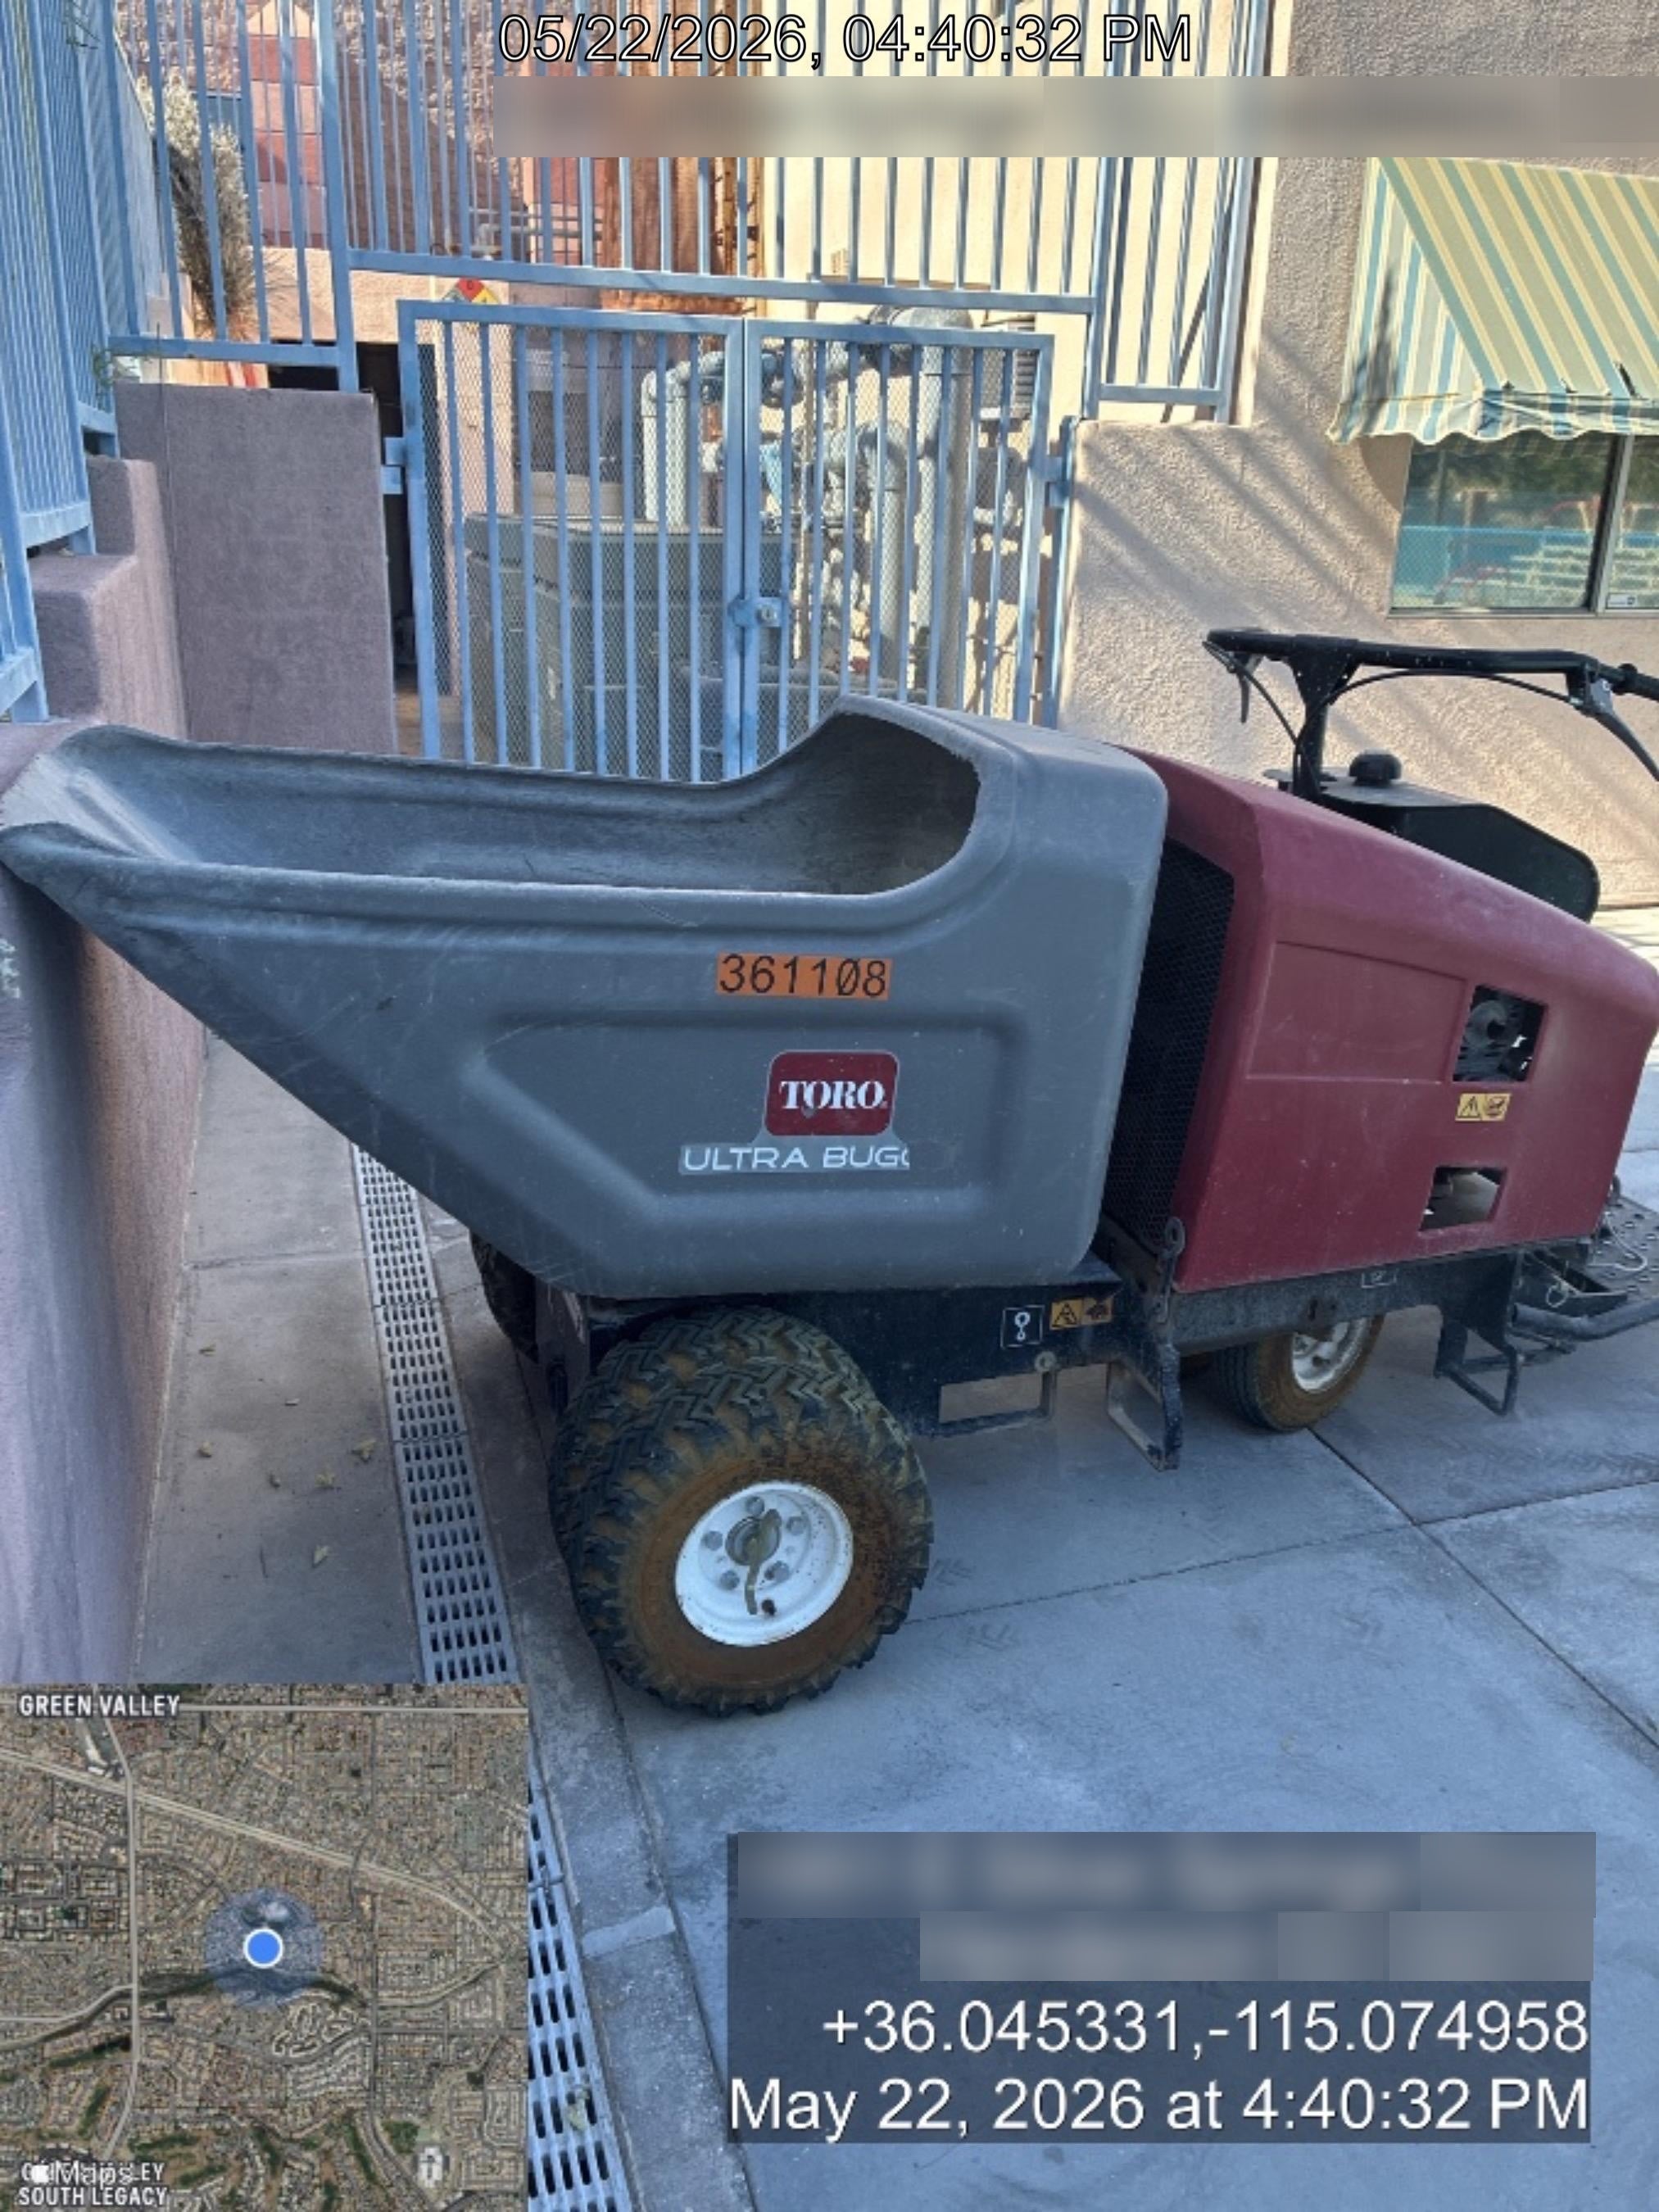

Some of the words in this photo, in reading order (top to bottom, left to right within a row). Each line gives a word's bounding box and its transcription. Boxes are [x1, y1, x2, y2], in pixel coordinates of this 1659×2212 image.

[719, 953, 886, 998] 361108
[780, 1081, 886, 1109] TORO
[683, 1147, 809, 1171] ULTRA
